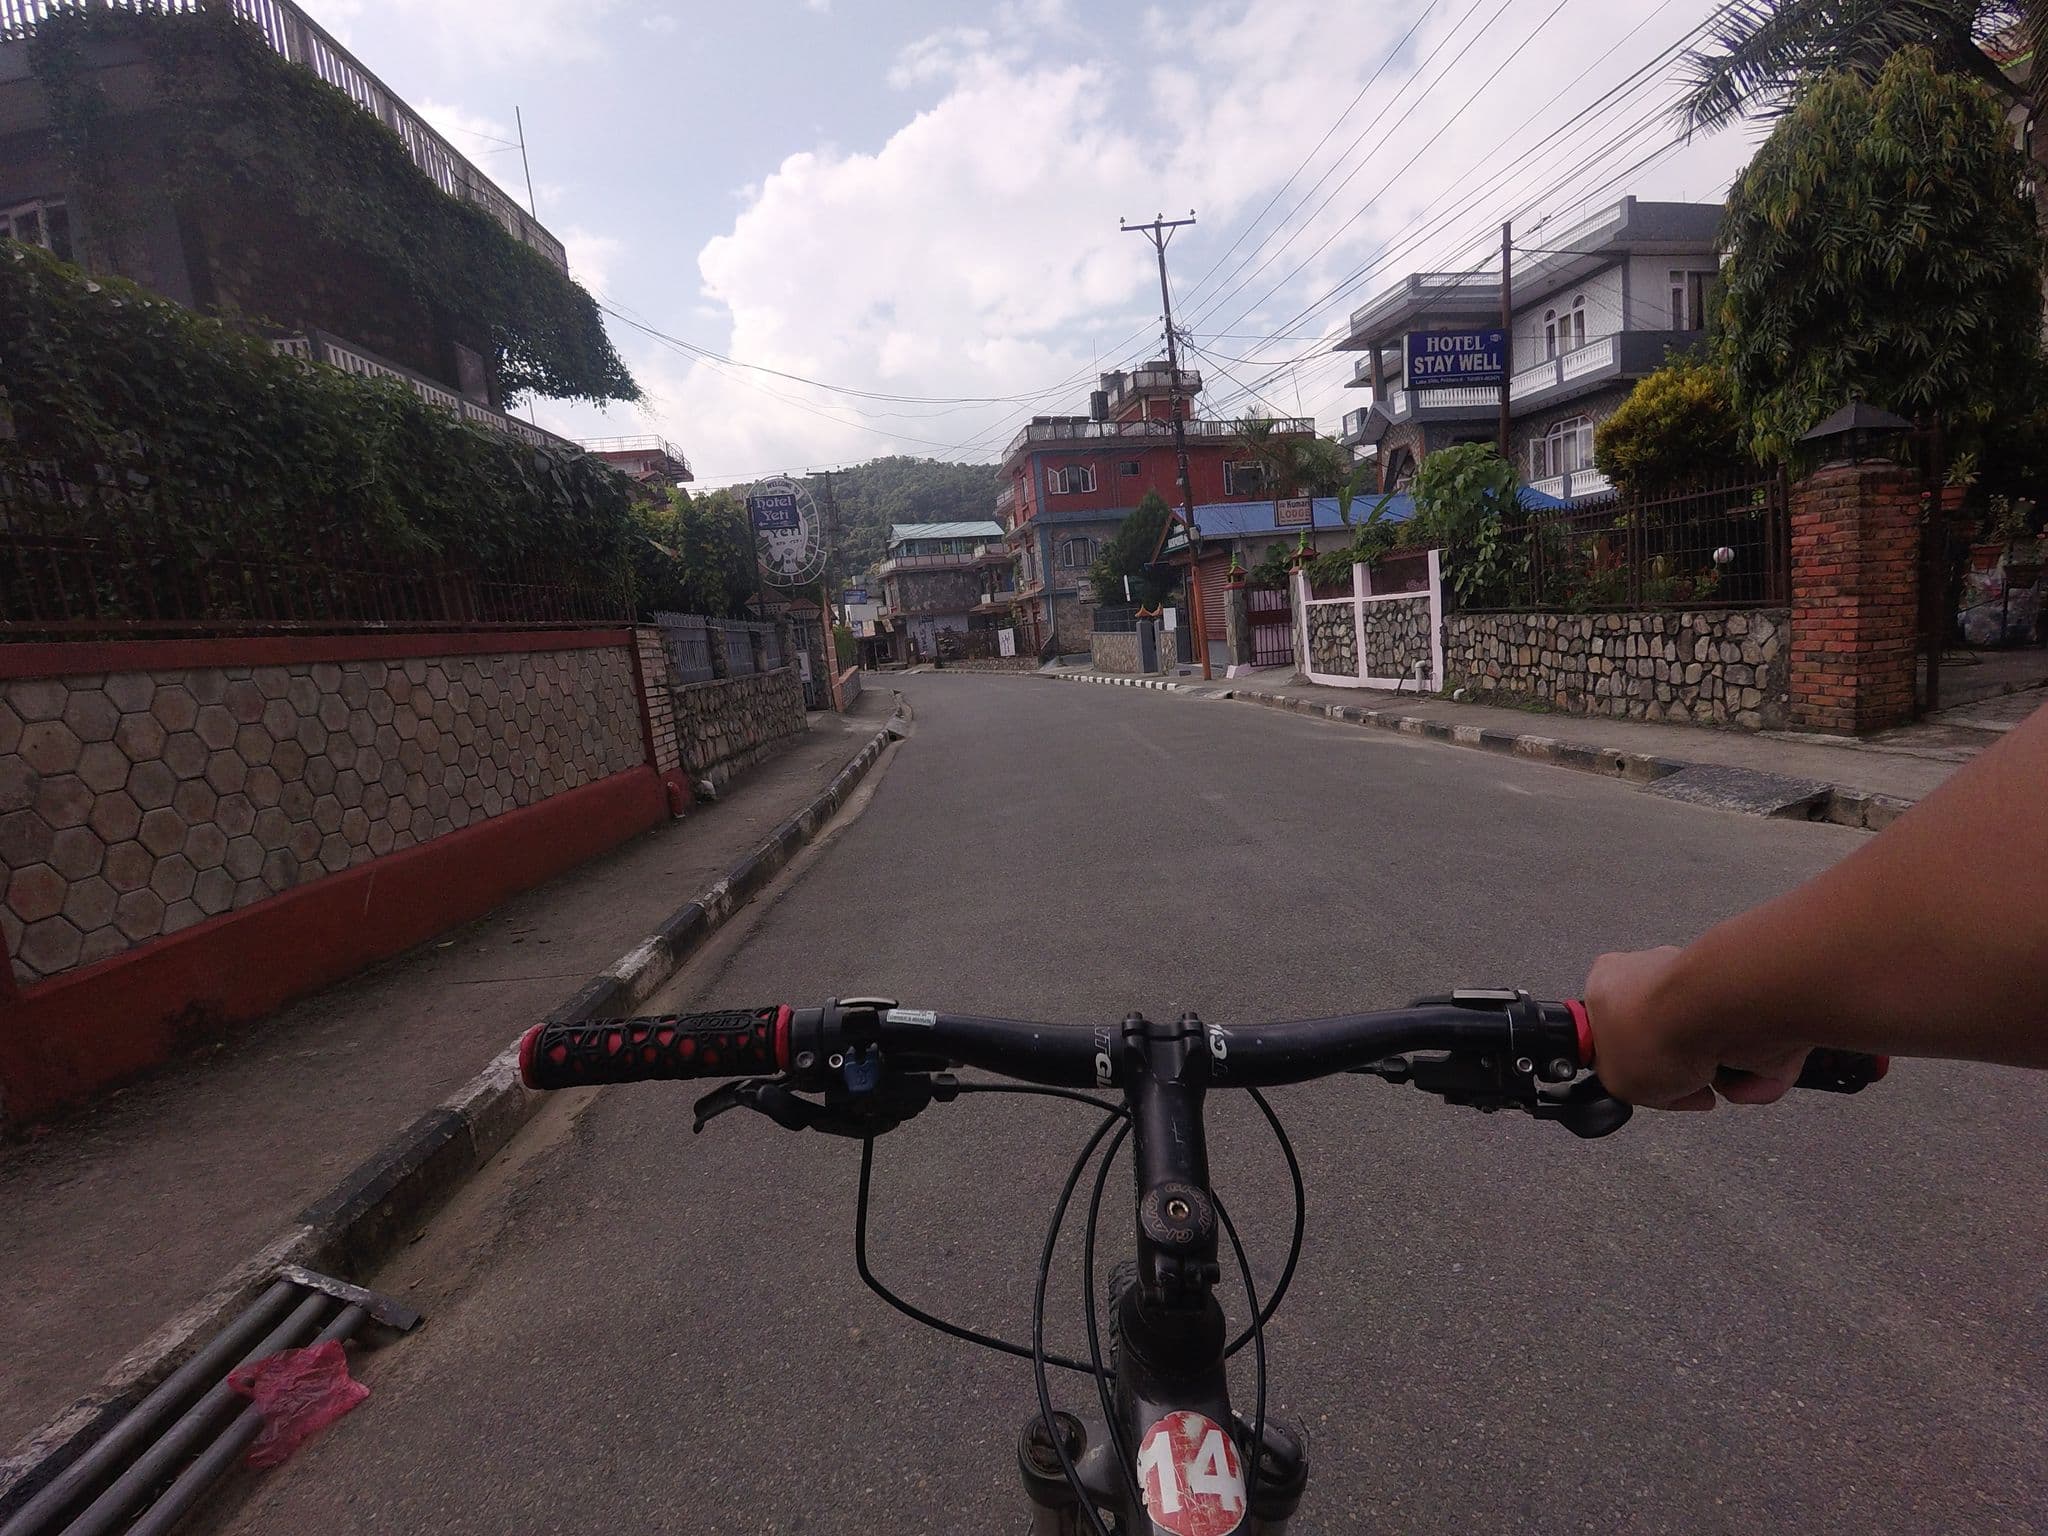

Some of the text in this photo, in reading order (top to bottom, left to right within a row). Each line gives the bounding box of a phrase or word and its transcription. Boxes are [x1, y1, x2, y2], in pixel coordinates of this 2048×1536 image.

[1426, 335, 1485, 353] HOTEL
[1414, 352, 1502, 375] STAY WELL
[761, 510, 789, 521] Yeti
[1280, 509, 1311, 518] LODGE
[1139, 1428, 1242, 1515] 14
